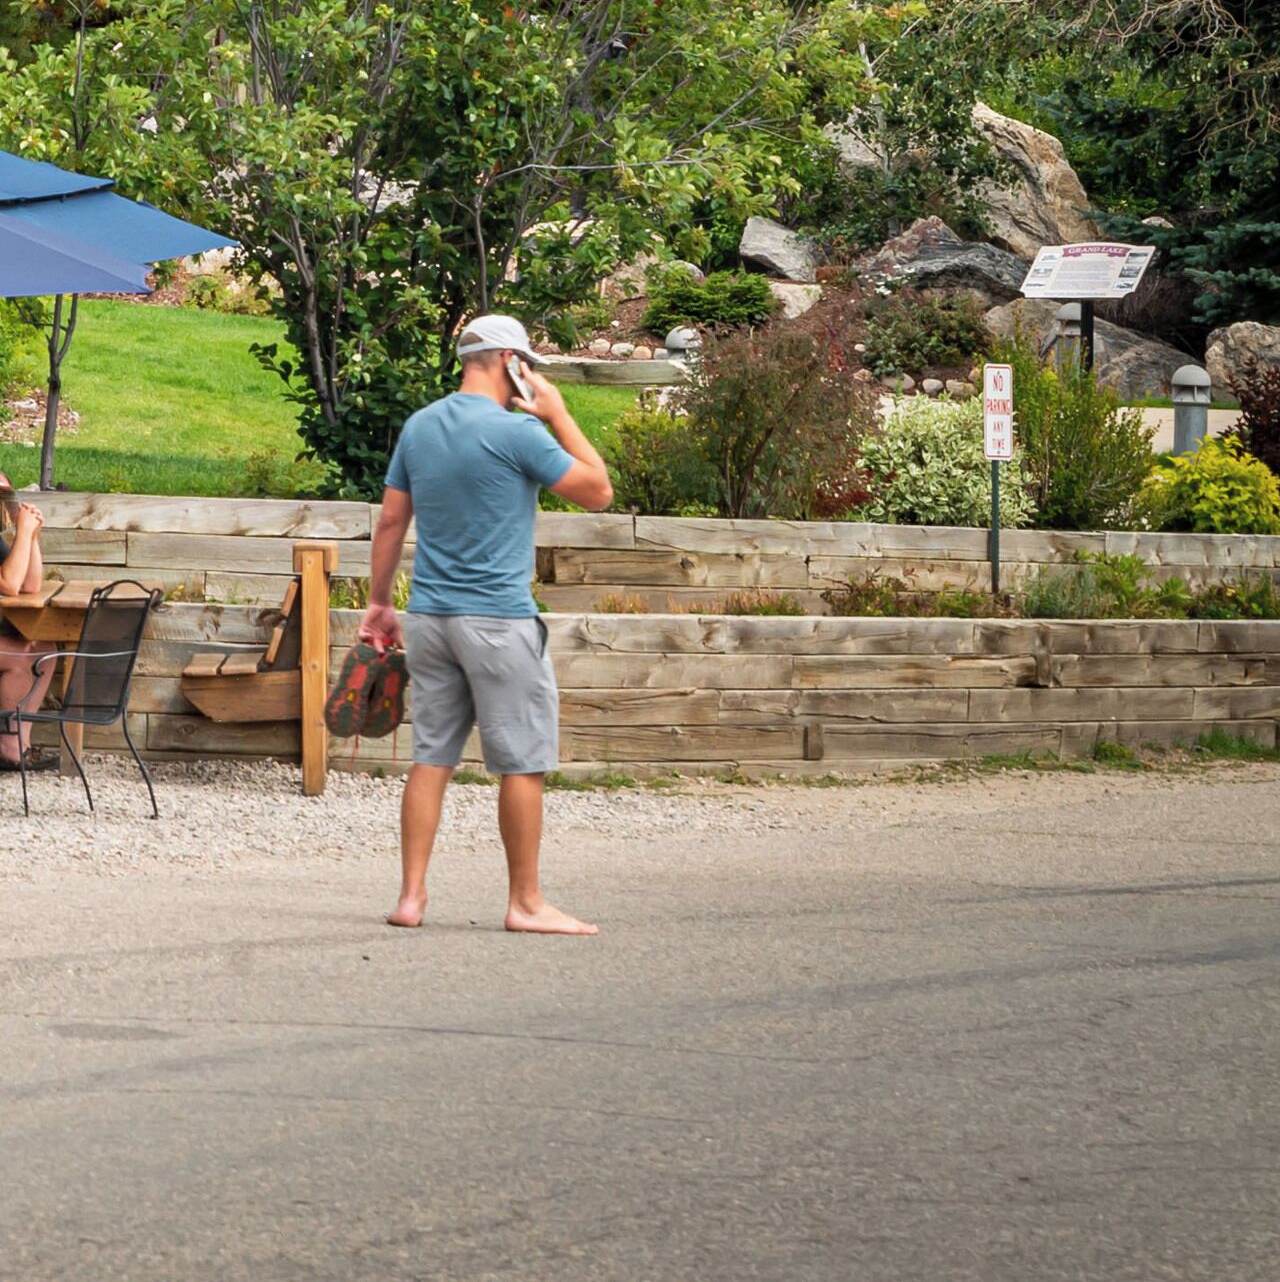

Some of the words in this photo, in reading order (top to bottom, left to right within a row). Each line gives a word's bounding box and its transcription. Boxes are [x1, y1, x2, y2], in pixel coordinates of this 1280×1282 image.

[1068, 246, 1100, 254] GRAND
[1100, 246, 1125, 255] LAKE
[992, 374, 1004, 392] NO
[986, 398, 1010, 416] PARKING
[993, 421, 1004, 433] ANY
[992, 438, 1005, 450] TIME
